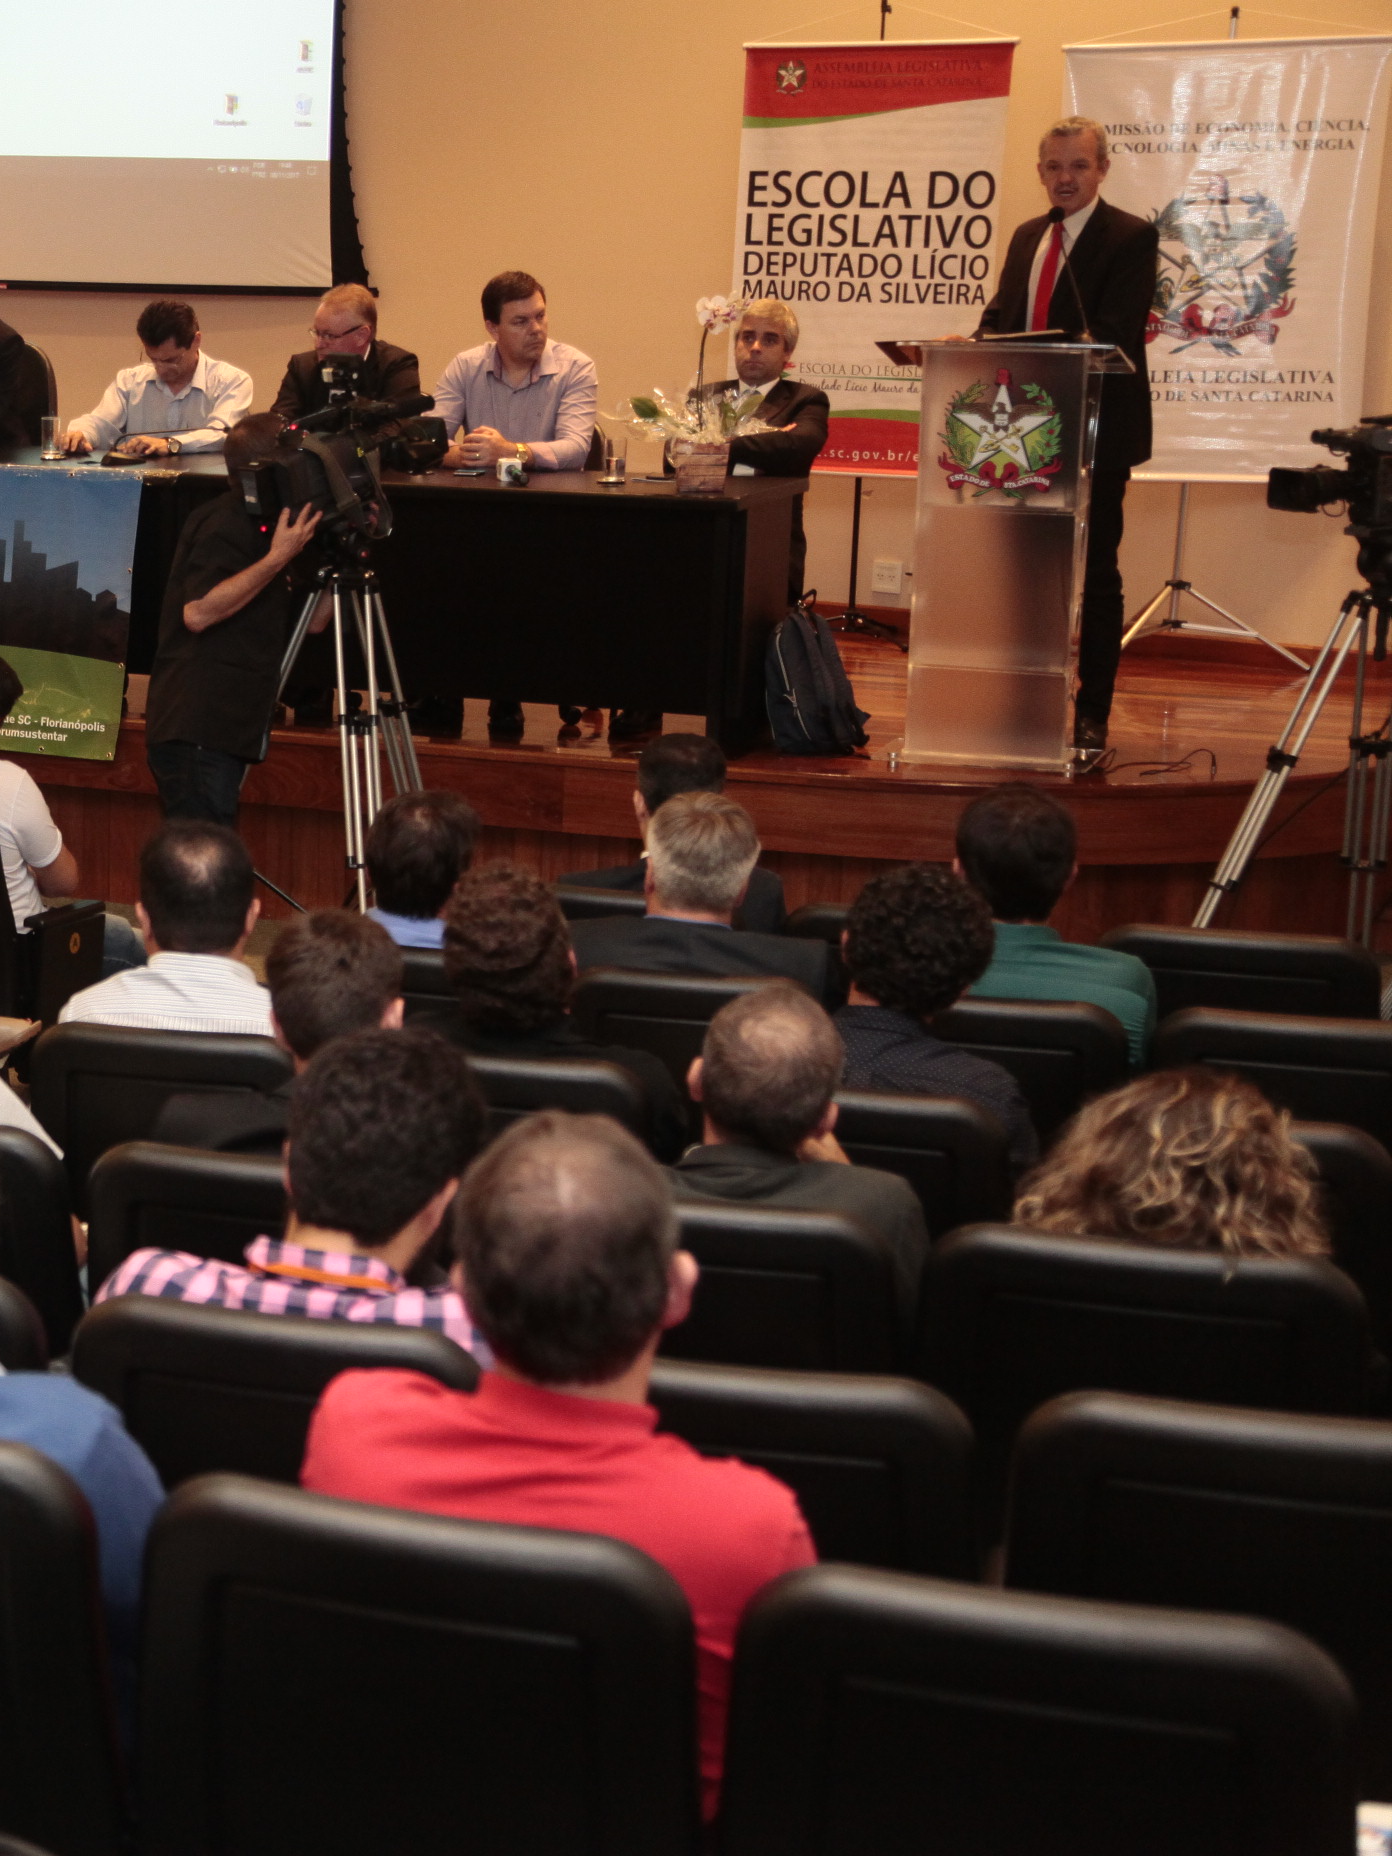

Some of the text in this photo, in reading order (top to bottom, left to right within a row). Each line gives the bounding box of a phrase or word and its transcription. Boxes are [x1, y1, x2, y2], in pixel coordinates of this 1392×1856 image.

[1105, 121, 1165, 135] MISSÃO
[747, 170, 996, 210] ESCOLA DO
[745, 213, 993, 249] LEGISLATIVO
[742, 249, 989, 281] DEPUTADO LÍCIO
[741, 279, 986, 305] MAURO DA SILVEIRA
[799, 363, 921, 378] ESCOLA DO LEGISL
[1150, 370, 1335, 384] LEIA LEGISLATIVA
[1165, 390, 1187, 402] DE
[1190, 390, 1244, 402] SANTA
[1248, 390, 1335, 403] CATARINA
[949, 473, 980, 485] ESTADO
[18, 714, 32, 725] SC
[41, 716, 106, 733] Florianópolis
